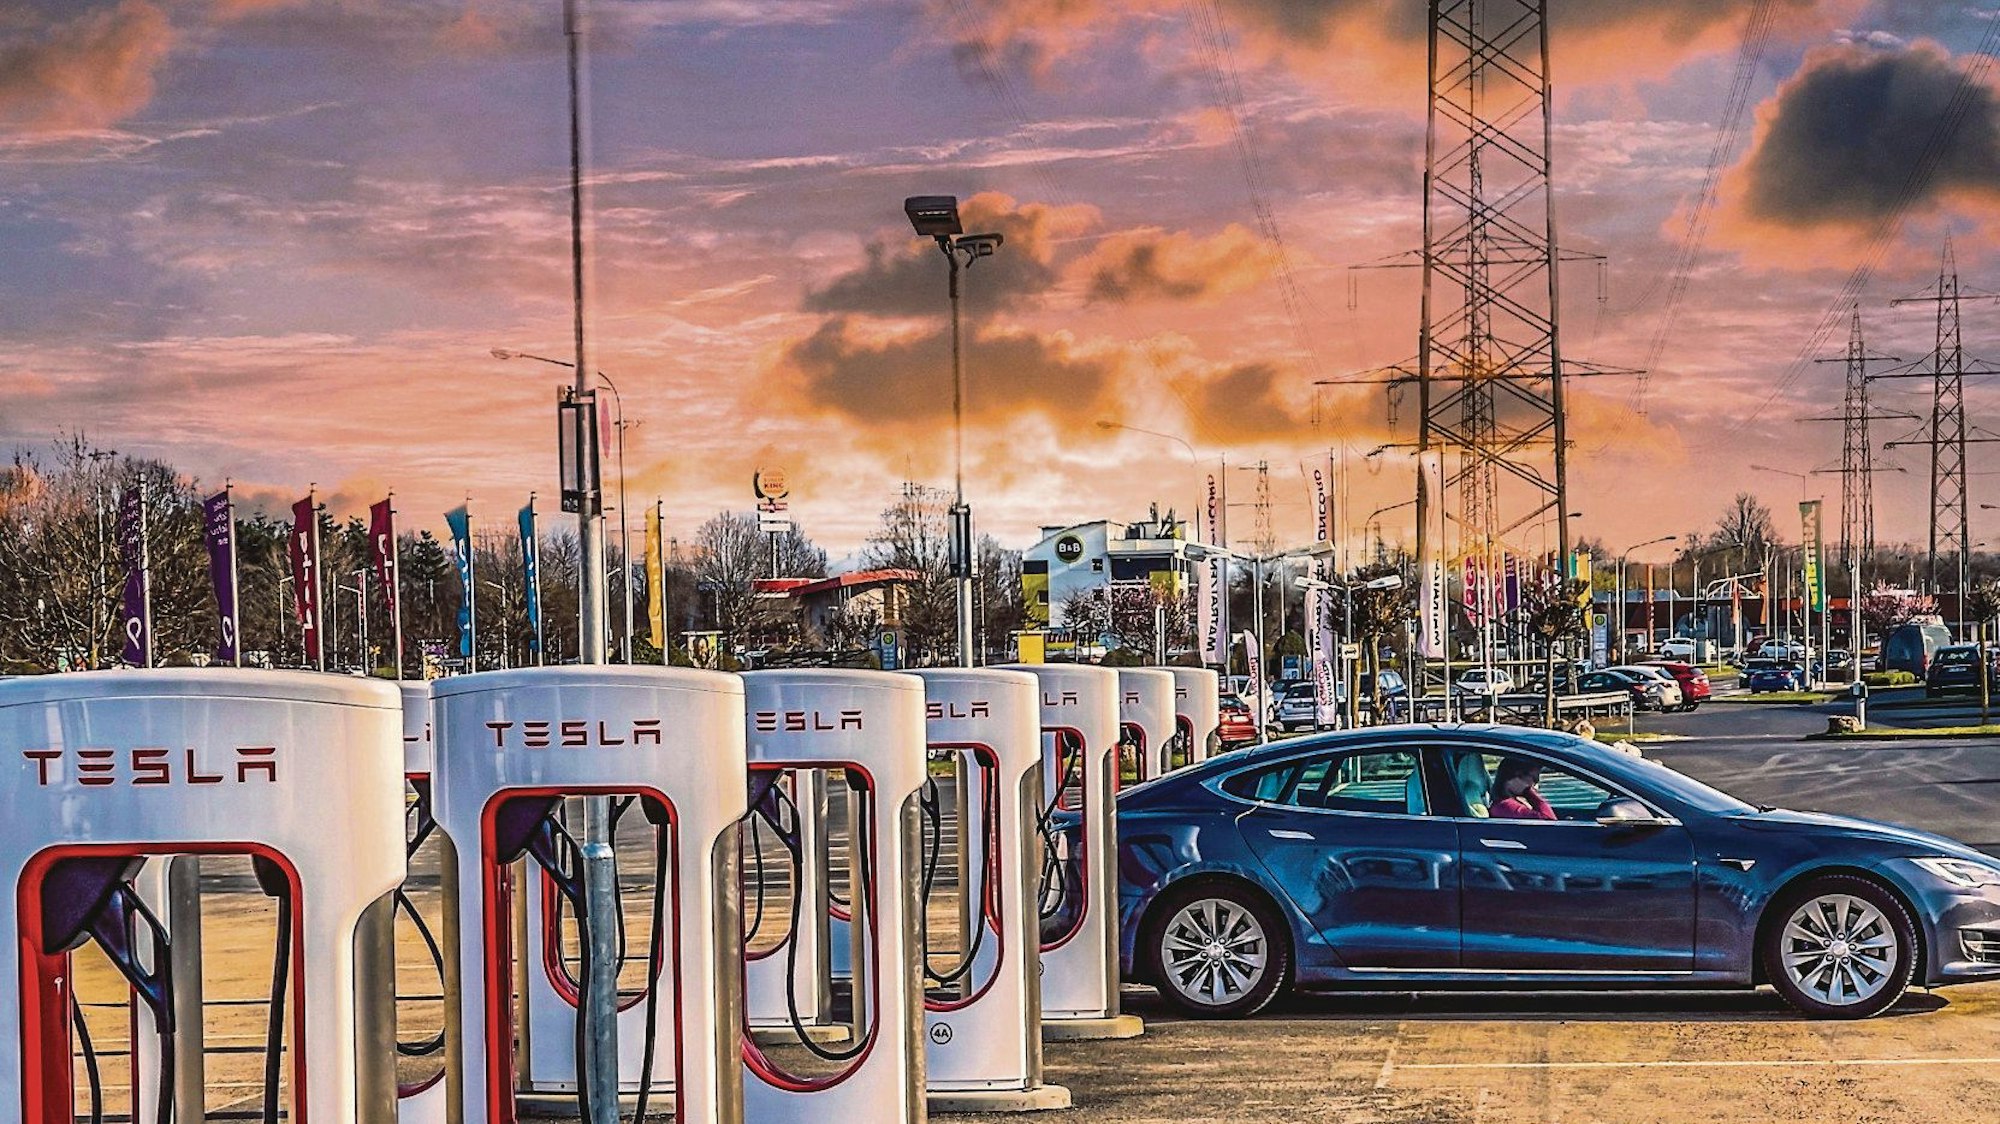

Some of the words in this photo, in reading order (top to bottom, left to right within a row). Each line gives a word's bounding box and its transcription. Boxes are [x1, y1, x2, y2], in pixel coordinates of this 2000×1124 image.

[1059, 543, 1081, 553] B&B
[926, 703, 989, 718] SLA
[756, 710, 862, 731] ESLA
[485, 719, 661, 747] TESLA
[22, 747, 276, 786] TESLA
[934, 1029, 949, 1037] 4A
